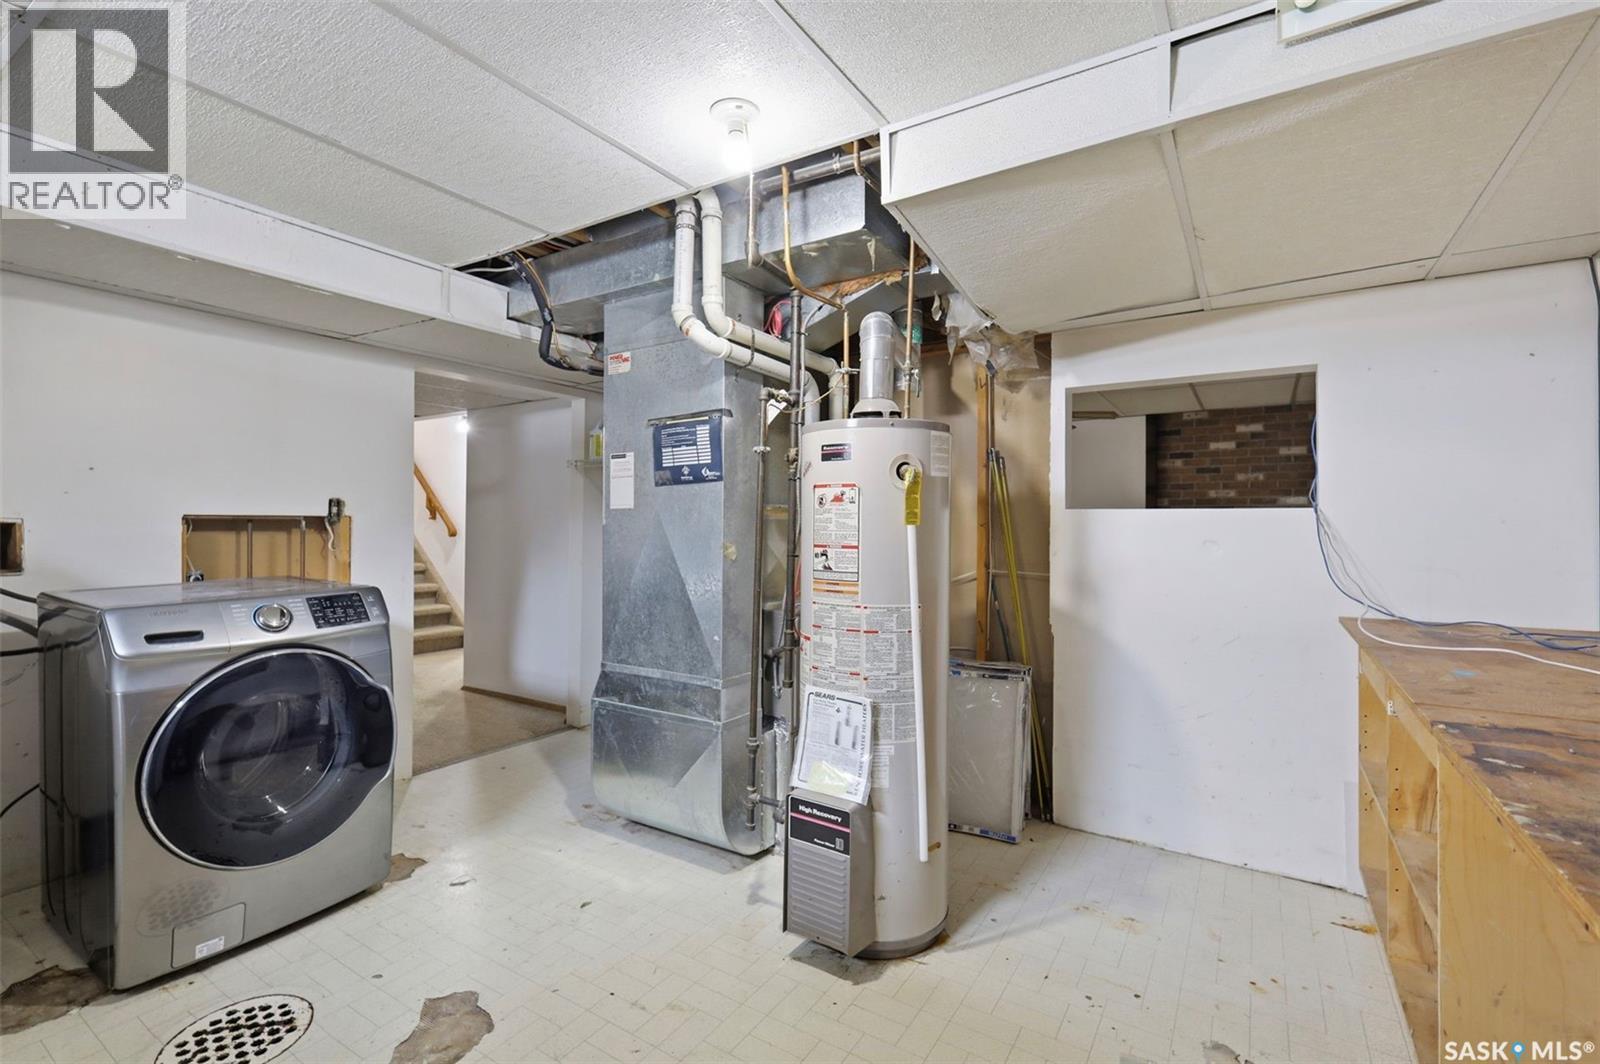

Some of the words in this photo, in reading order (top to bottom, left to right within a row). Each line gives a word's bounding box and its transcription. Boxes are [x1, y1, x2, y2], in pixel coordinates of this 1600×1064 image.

[814, 691, 836, 701] SEARS
[799, 804, 813, 814] High
[812, 808, 842, 823] Recovery
